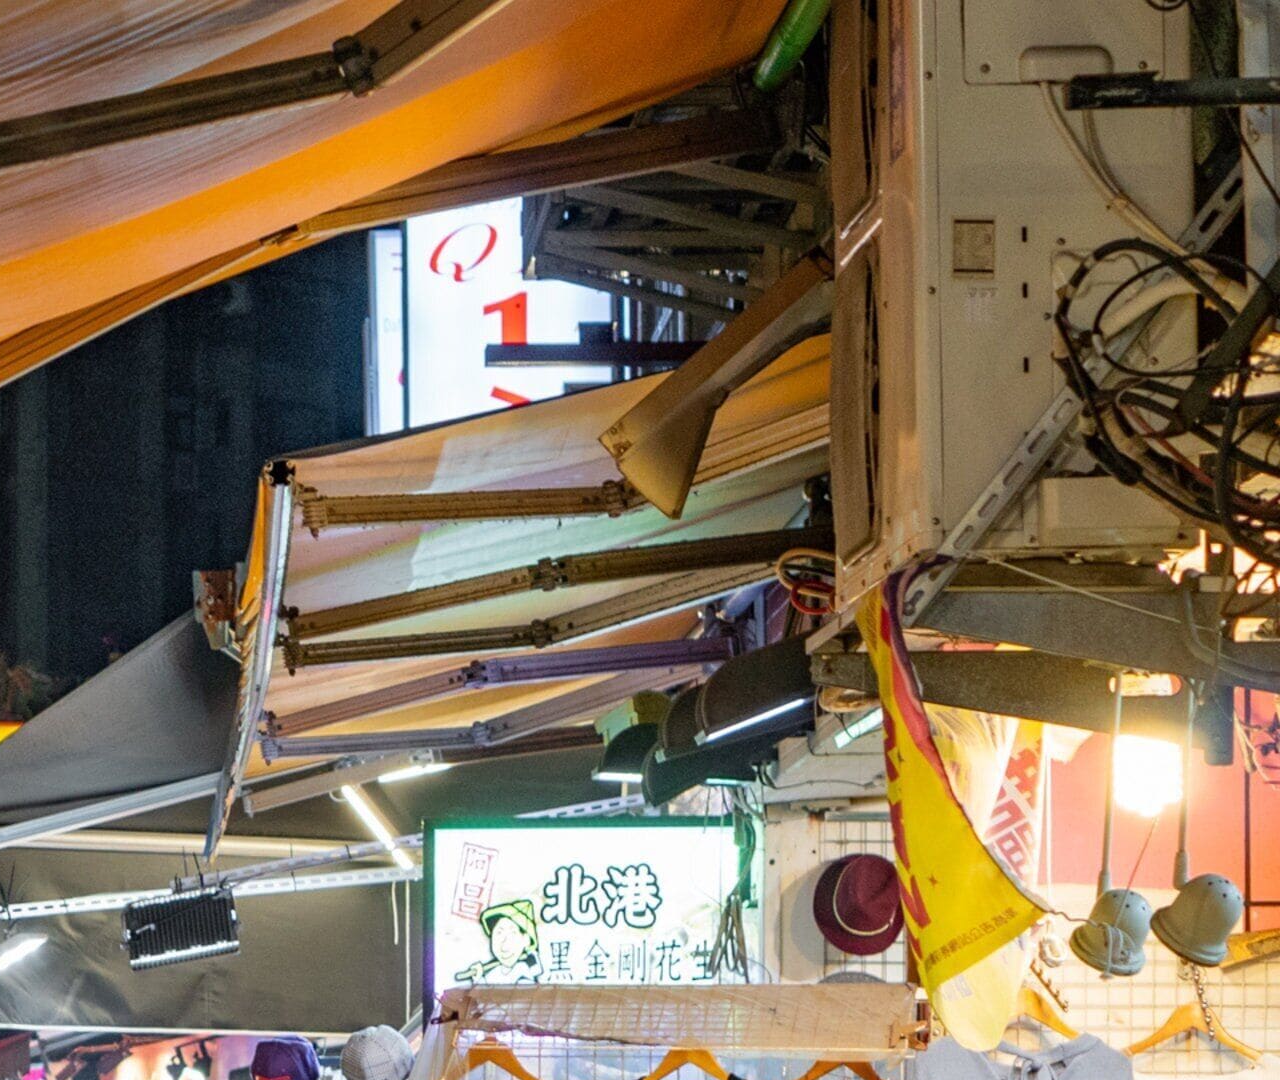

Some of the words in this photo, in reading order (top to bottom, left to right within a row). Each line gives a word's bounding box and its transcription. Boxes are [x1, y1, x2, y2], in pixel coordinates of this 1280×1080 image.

[540, 863, 663, 929] 北港
[549, 939, 716, 982] 黑金剛花生
